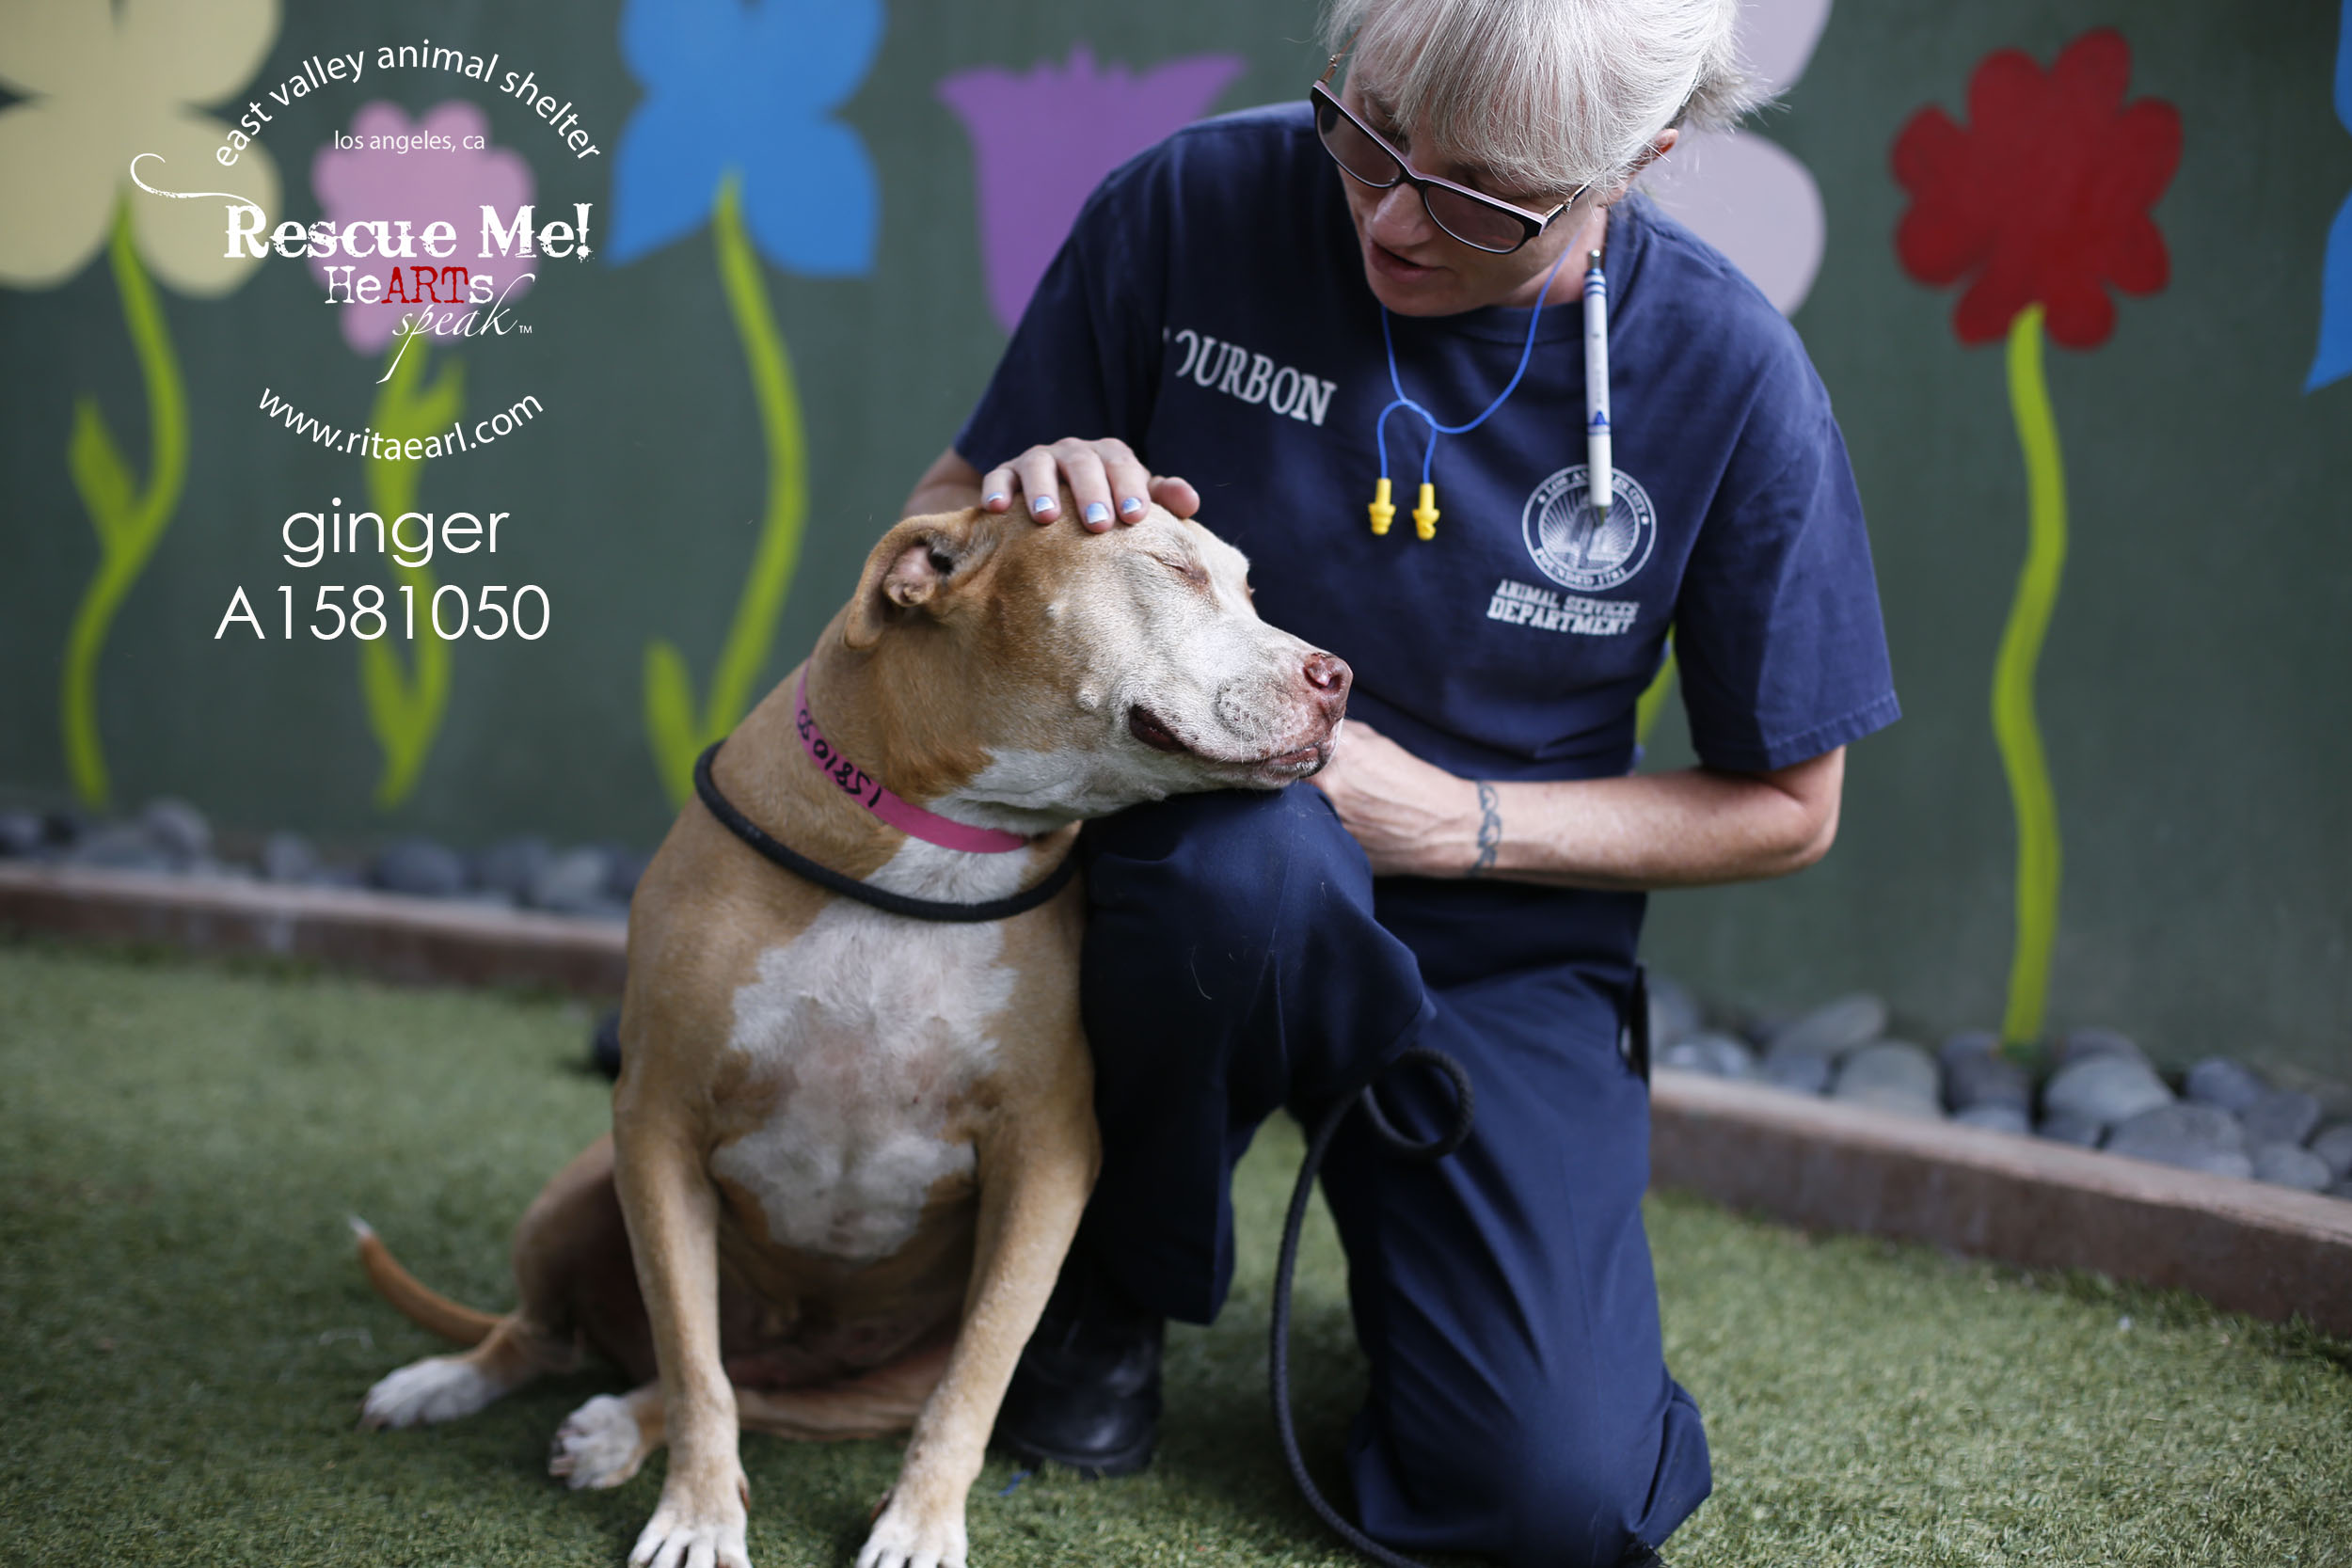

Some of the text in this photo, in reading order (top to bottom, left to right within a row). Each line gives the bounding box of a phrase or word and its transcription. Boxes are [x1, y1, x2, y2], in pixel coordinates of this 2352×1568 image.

[1162, 325, 1338, 427] OURBON
[1486, 596, 1636, 636] DEPARTMENT
[1496, 579, 1640, 620] ANIMAL SERVICES
